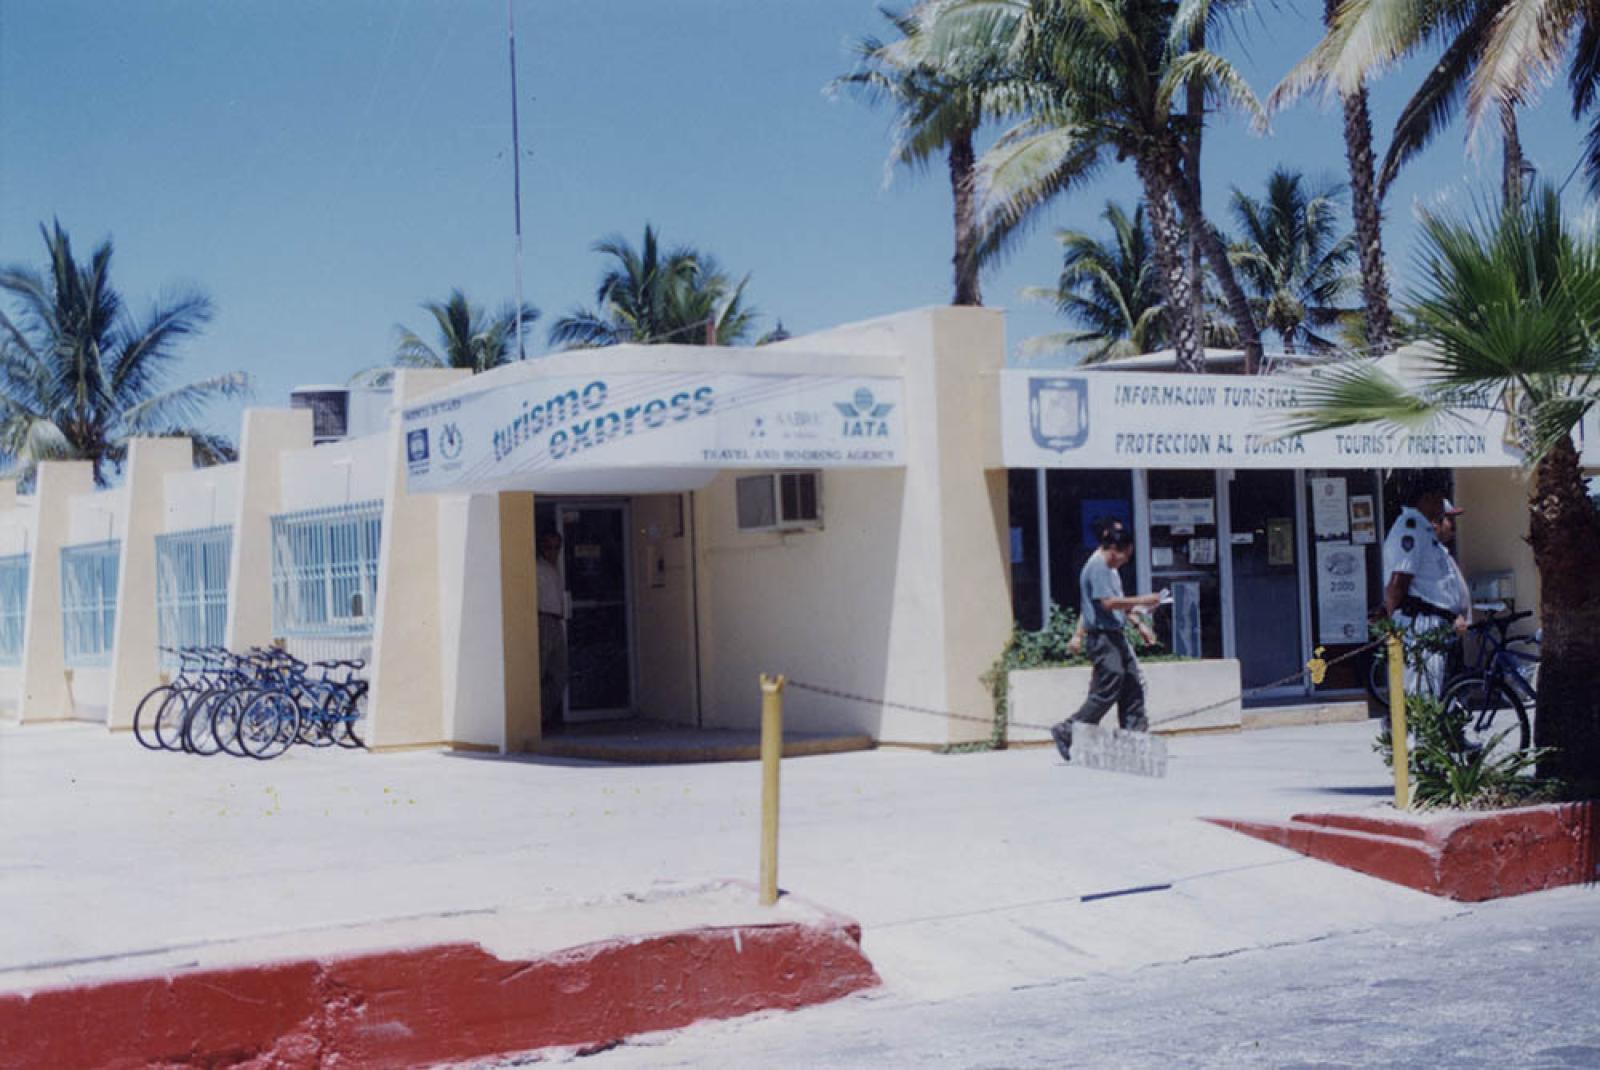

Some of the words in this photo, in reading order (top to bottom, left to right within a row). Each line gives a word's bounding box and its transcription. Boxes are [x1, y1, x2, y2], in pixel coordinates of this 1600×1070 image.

[1114, 385, 1217, 407] INFORMACION
[493, 381, 607, 462] turismo
[551, 386, 714, 460] express
[842, 421, 889, 437] IATA
[1115, 432, 1211, 454] PROTECCION
[1216, 433, 1234, 454] AL
[1335, 434, 1394, 455] TOURIST
[1407, 434, 1486, 455] PROTECTION
